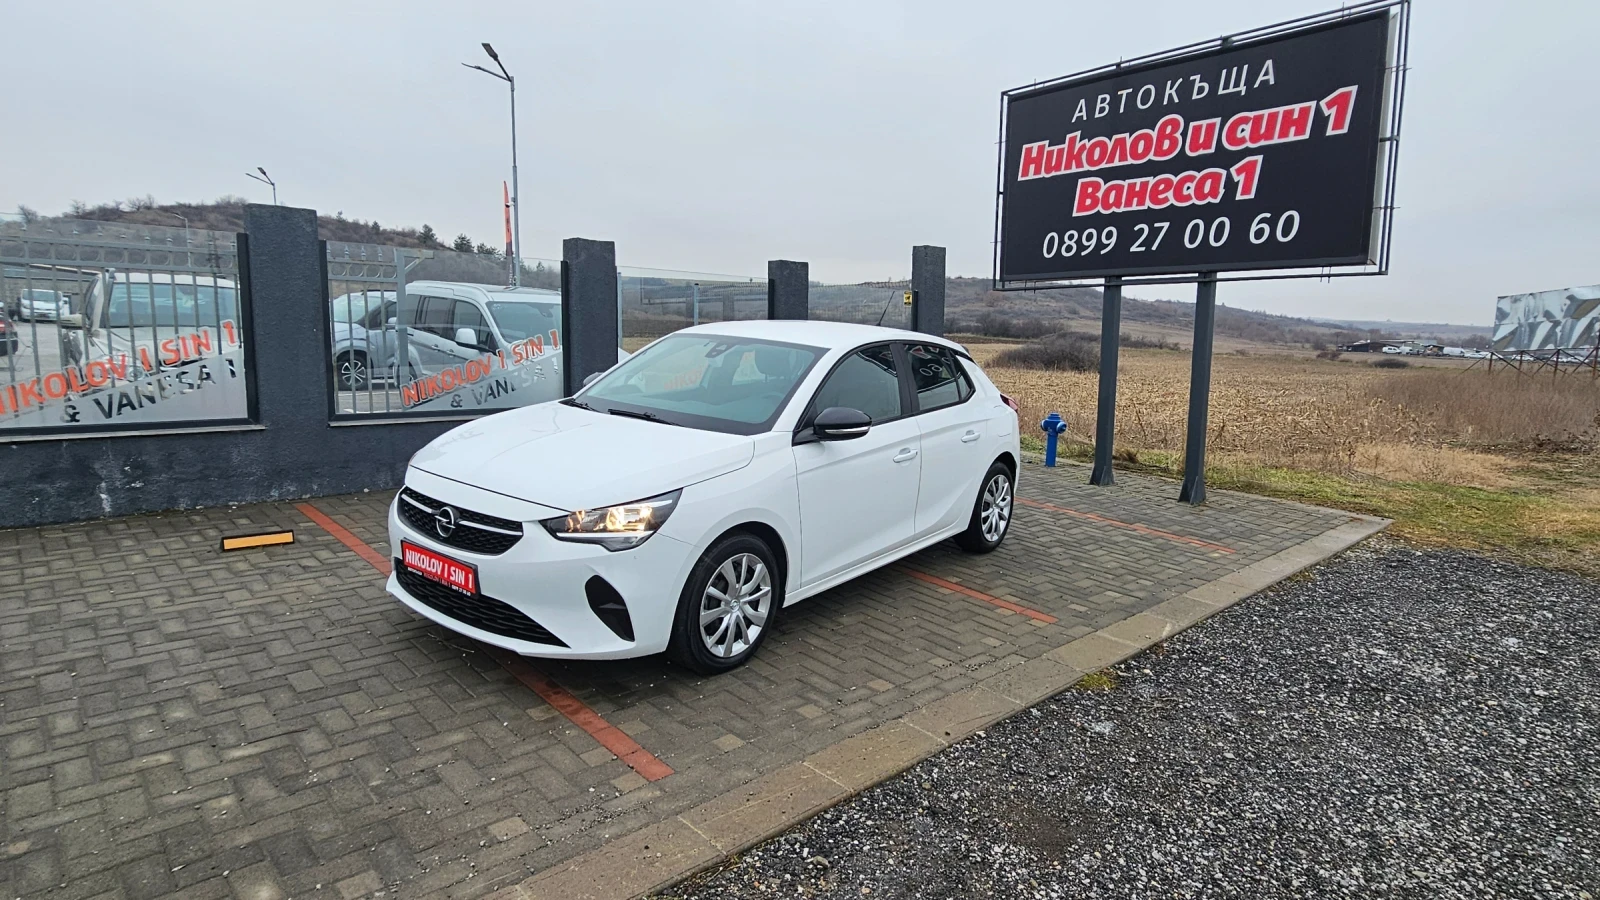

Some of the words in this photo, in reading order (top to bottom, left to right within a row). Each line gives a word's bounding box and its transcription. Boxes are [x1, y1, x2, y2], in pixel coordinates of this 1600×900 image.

[1071, 59, 1276, 123] АВТОКЪЩА
[1018, 113, 1184, 181] Николов
[1185, 118, 1221, 157] и
[1222, 100, 1317, 151] син
[1320, 84, 1359, 136] 1
[1072, 167, 1227, 217] Ванеса
[1231, 155, 1264, 201] 1
[1042, 225, 1118, 259] 0899
[1130, 222, 1171, 253] 27
[1183, 216, 1231, 249] 00
[1249, 210, 1300, 244] 60
[139, 347, 153, 372] I
[161, 330, 211, 366] SIN
[222, 321, 237, 345] 1
[402, 354, 492, 407] NIKOLOV
[497, 350, 506, 369] I
[511, 336, 544, 365] SIN
[549, 330, 560, 349] 1
[61, 404, 80, 423] &
[93, 364, 216, 419] VANESA
[226, 358, 237, 379] 1
[450, 394, 463, 408] &
[405, 548, 443, 575] NIKOLOV
[450, 566, 465, 586] SIN
[468, 573, 473, 589] 1
